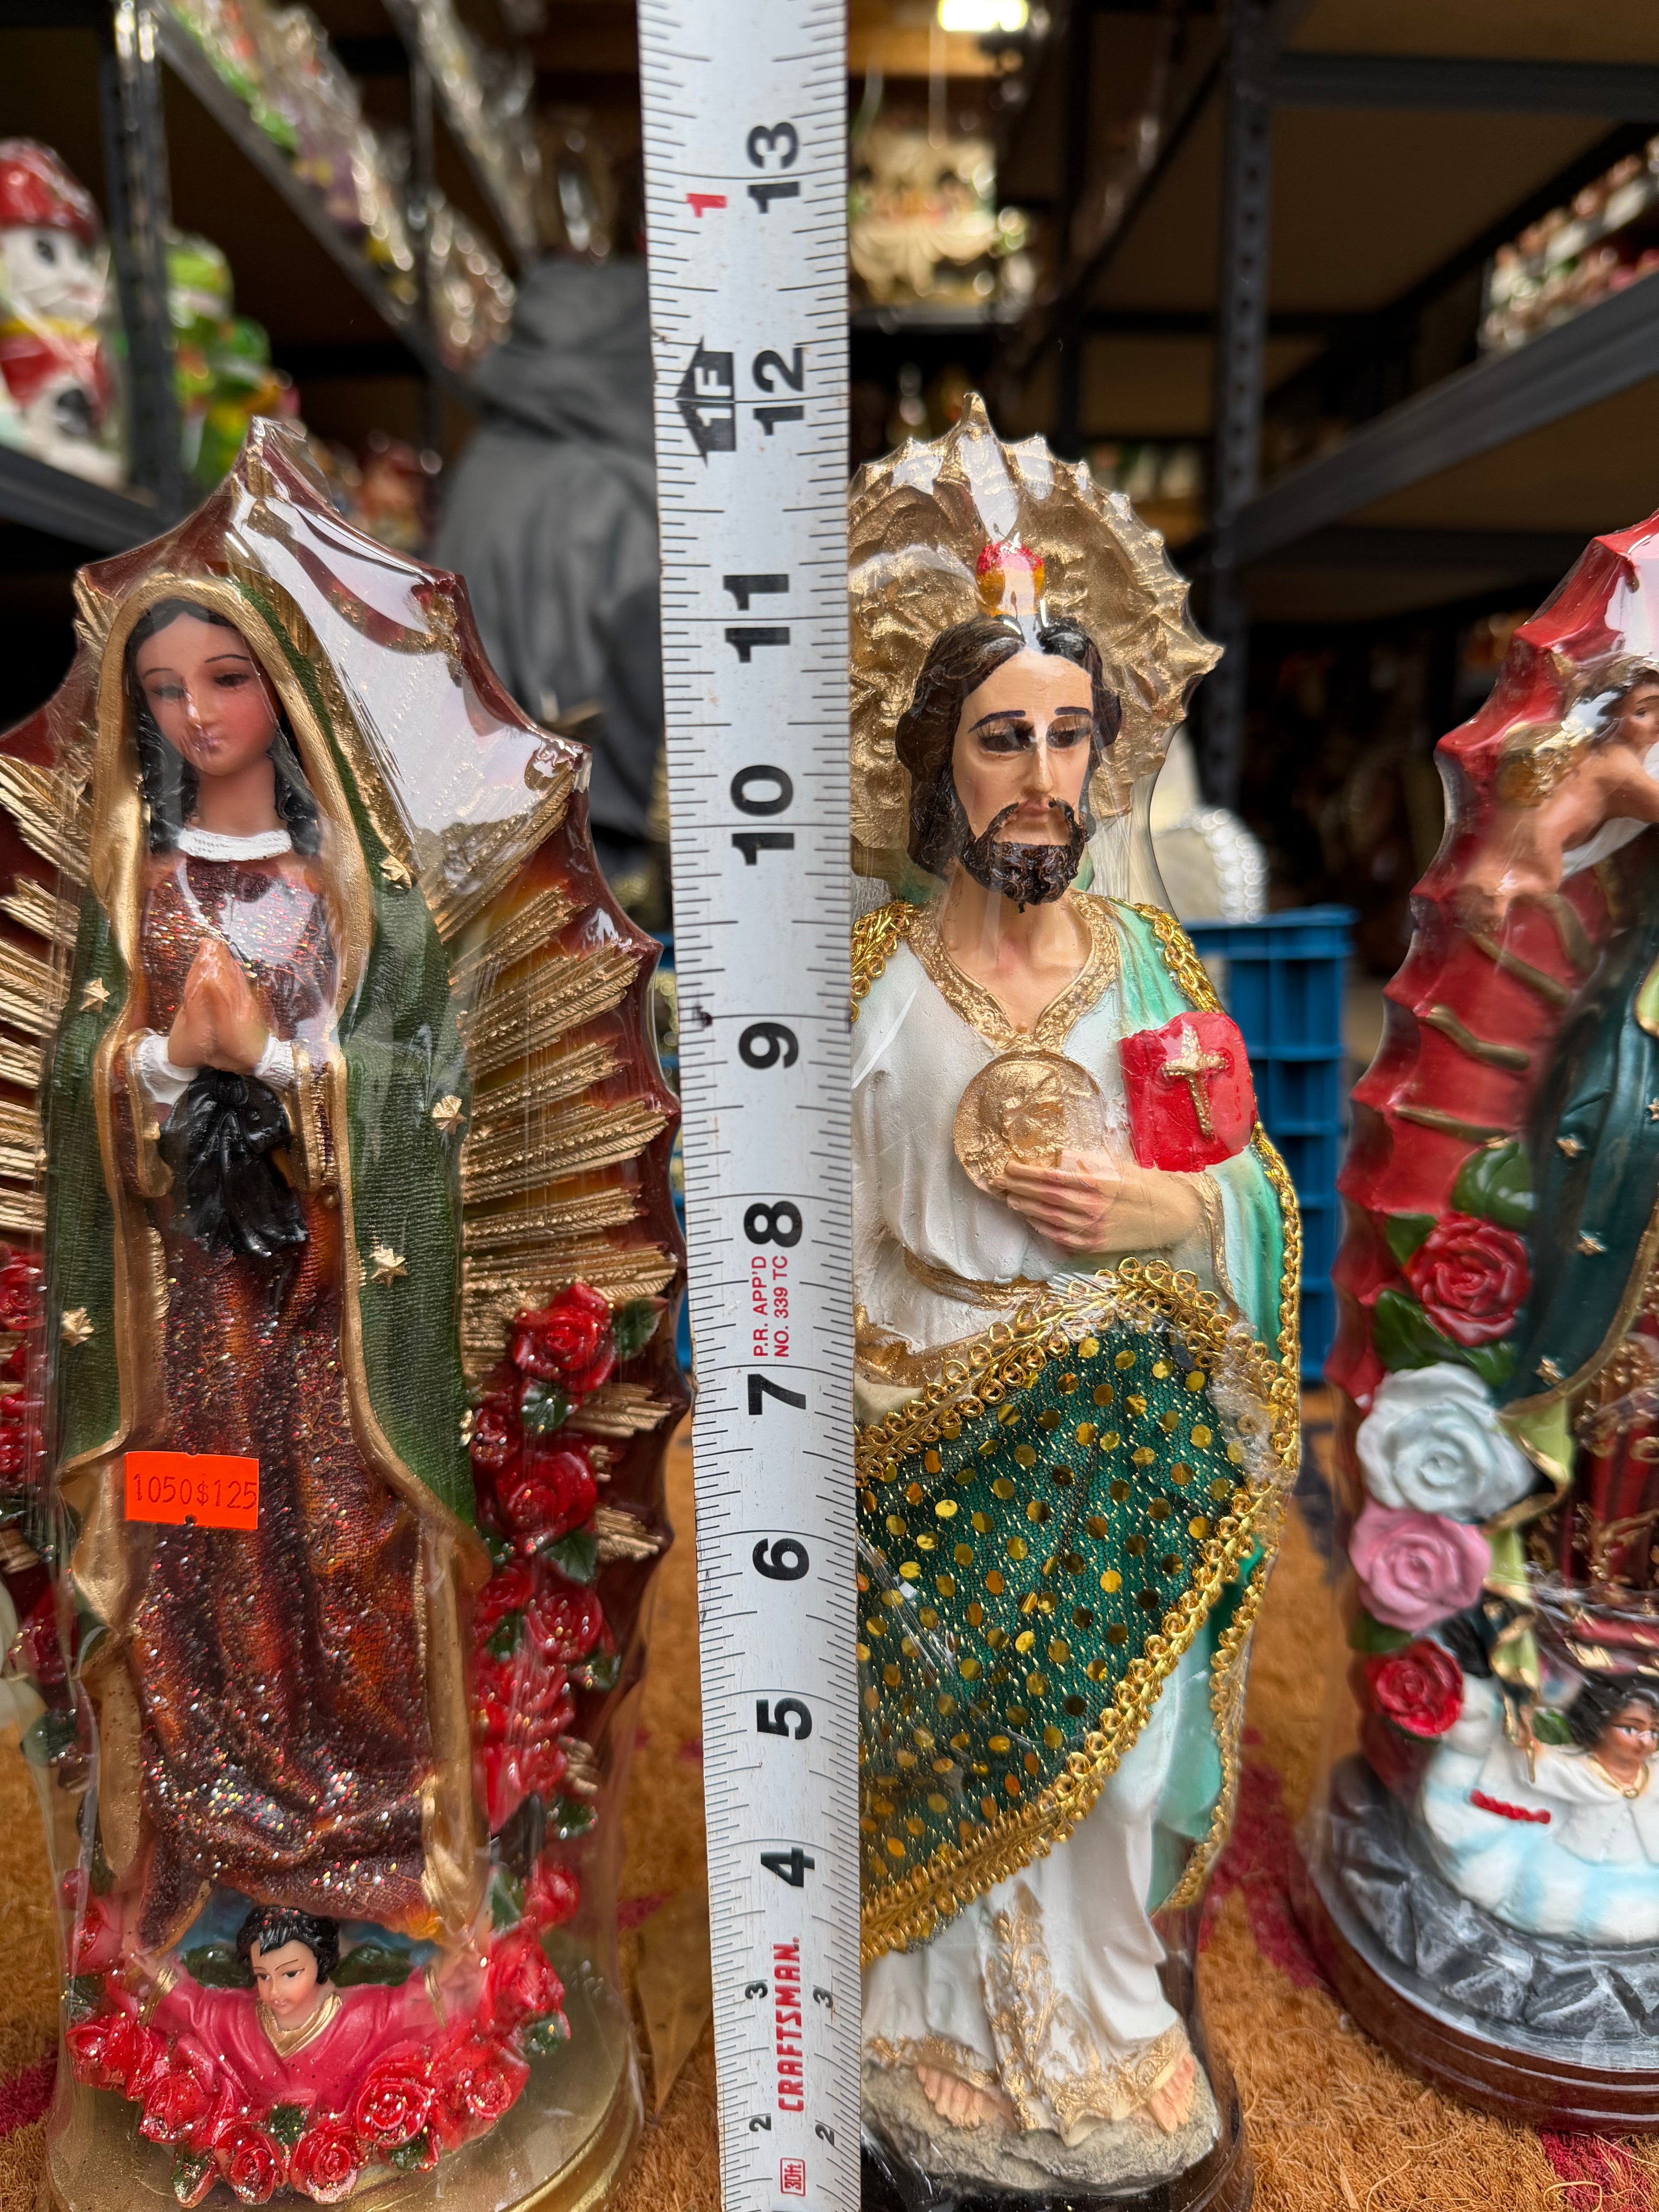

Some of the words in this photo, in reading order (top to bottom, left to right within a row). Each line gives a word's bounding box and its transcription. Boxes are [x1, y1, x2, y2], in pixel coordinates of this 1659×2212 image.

[746, 121, 800, 214] 13
[686, 193, 728, 218] 1
[694, 366, 732, 427] 1F
[752, 347, 804, 436] 12
[722, 574, 790, 663] 11
[730, 764, 795, 865] 10
[738, 1022, 799, 1070] 9
[744, 1201, 803, 1248] 8
[751, 1255, 768, 1316] APP'D
[772, 1255, 788, 1281] TC
[773, 1286, 789, 1319] 339
[753, 1322, 769, 1357] P.R.
[773, 1325, 789, 1357] NO.
[747, 1373, 806, 1415] 7
[752, 1538, 810, 1581] 6
[756, 1697, 812, 1740] 5
[760, 1847, 815, 1888] 4
[744, 1981, 769, 1999] 3
[812, 1987, 834, 2008] 3
[748, 2115, 772, 2132] 2
[815, 2123, 835, 2146] 2
